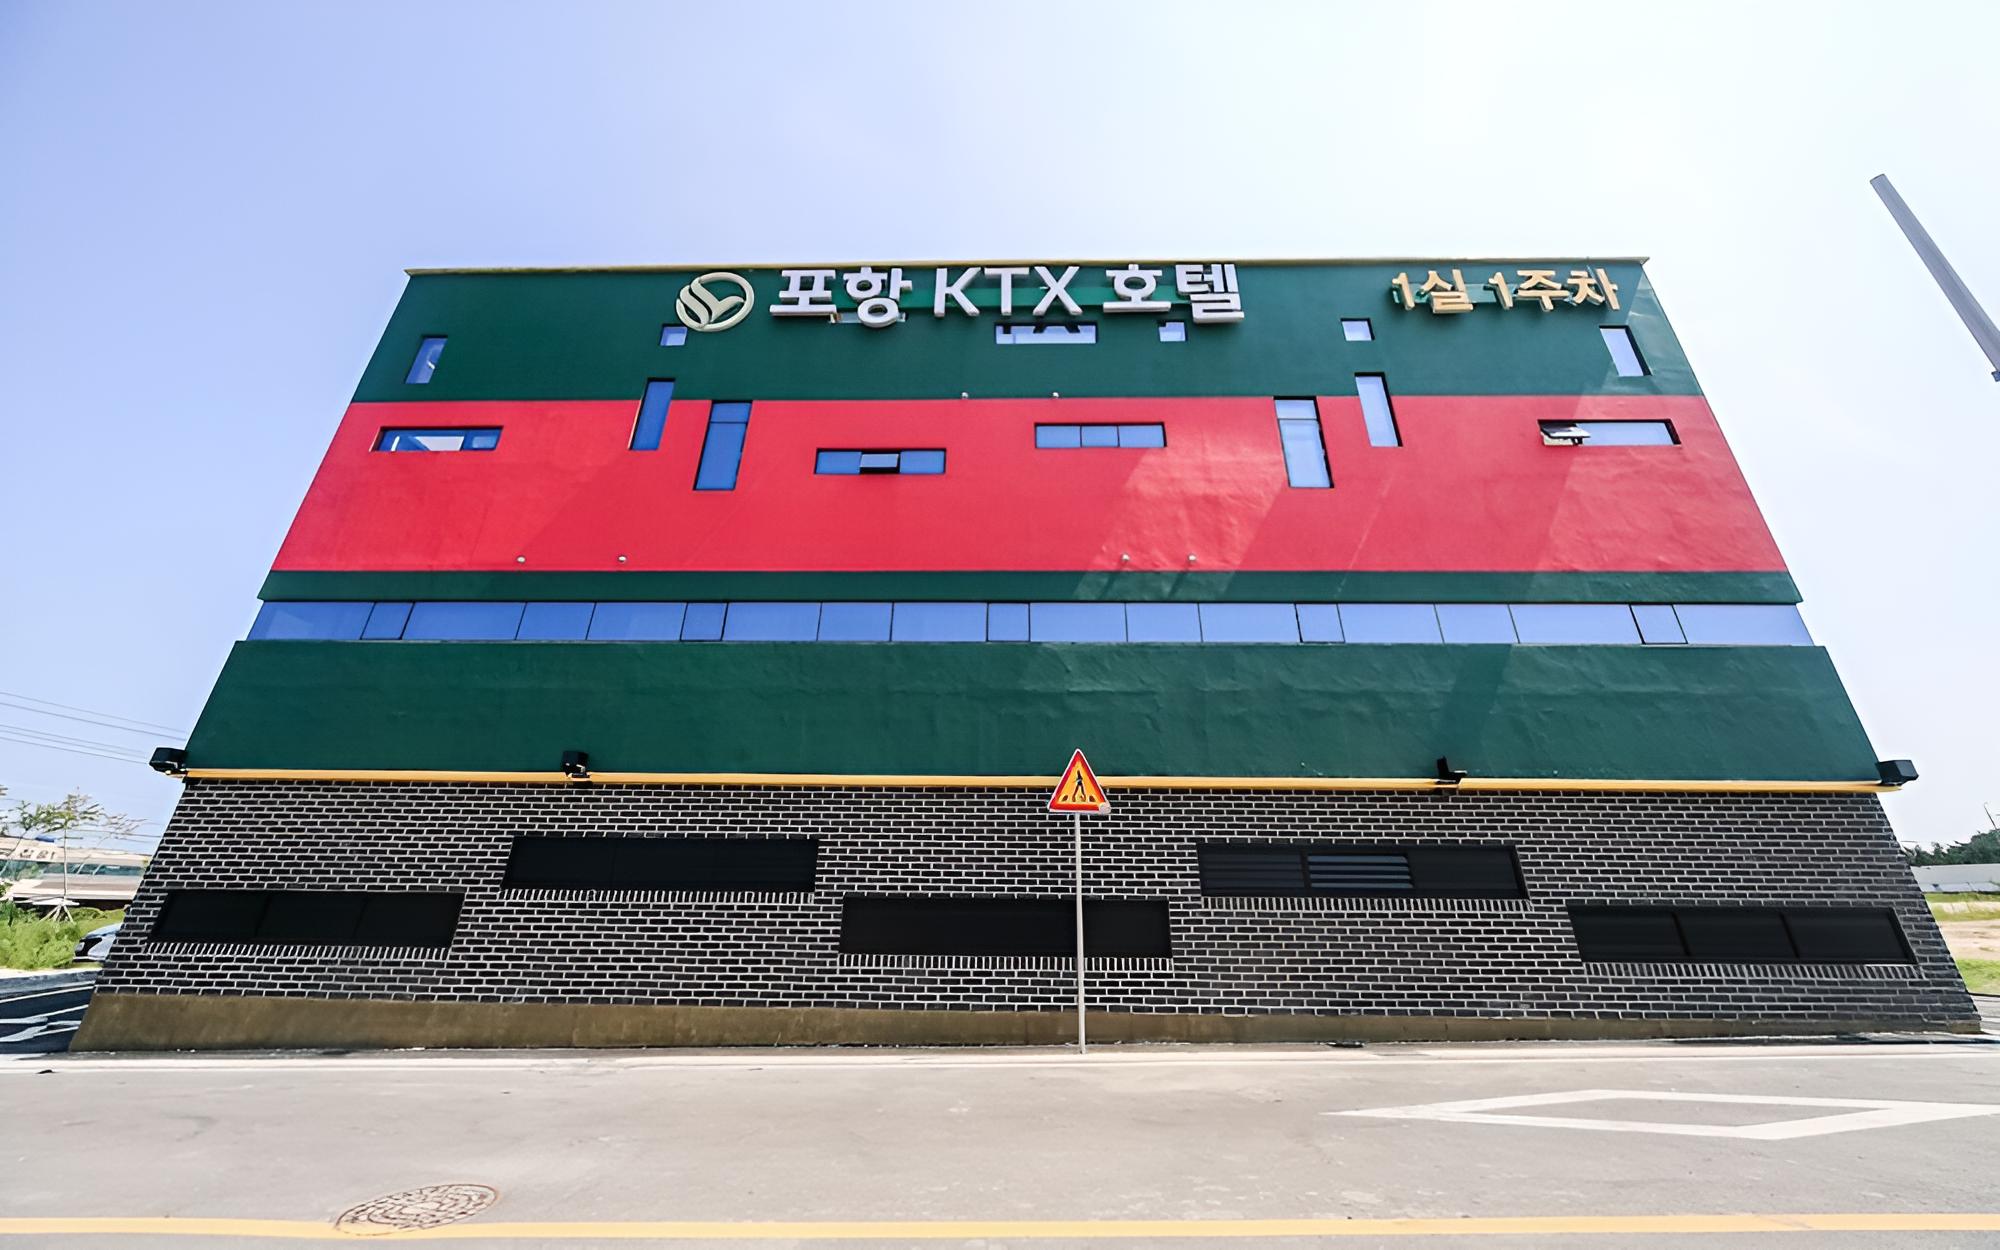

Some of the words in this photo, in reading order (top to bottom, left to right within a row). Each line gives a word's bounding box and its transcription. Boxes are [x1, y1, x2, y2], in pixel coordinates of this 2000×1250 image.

[769, 266, 912, 328] 포항
[933, 266, 1083, 316] KTX
[1103, 263, 1245, 324] 호텔
[1392, 269, 1474, 314] 1실
[1488, 269, 1620, 312] 1주차
